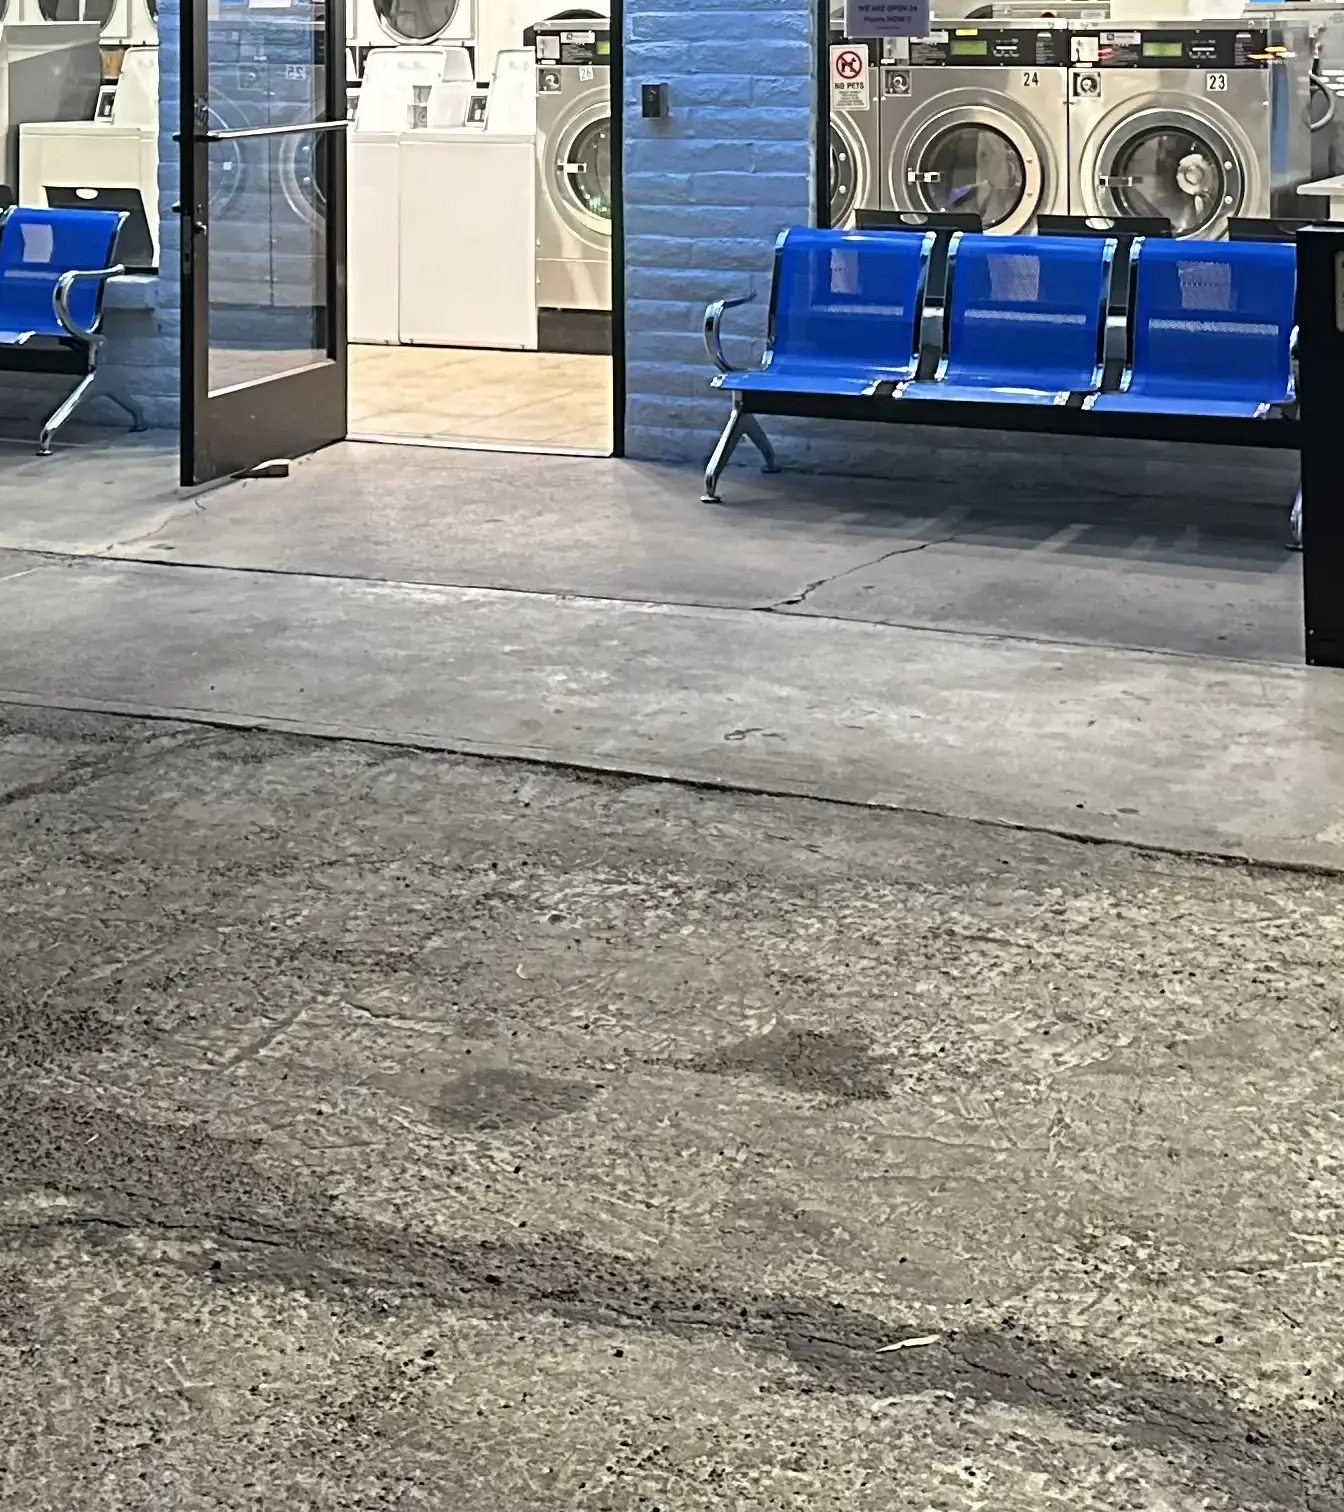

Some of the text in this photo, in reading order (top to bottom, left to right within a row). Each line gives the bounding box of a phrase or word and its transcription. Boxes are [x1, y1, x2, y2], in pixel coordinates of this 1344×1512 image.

[580, 67, 592, 80] 26
[1023, 71, 1039, 87] 24
[834, 81, 865, 90] NO PETS
[1208, 74, 1227, 90] 23
